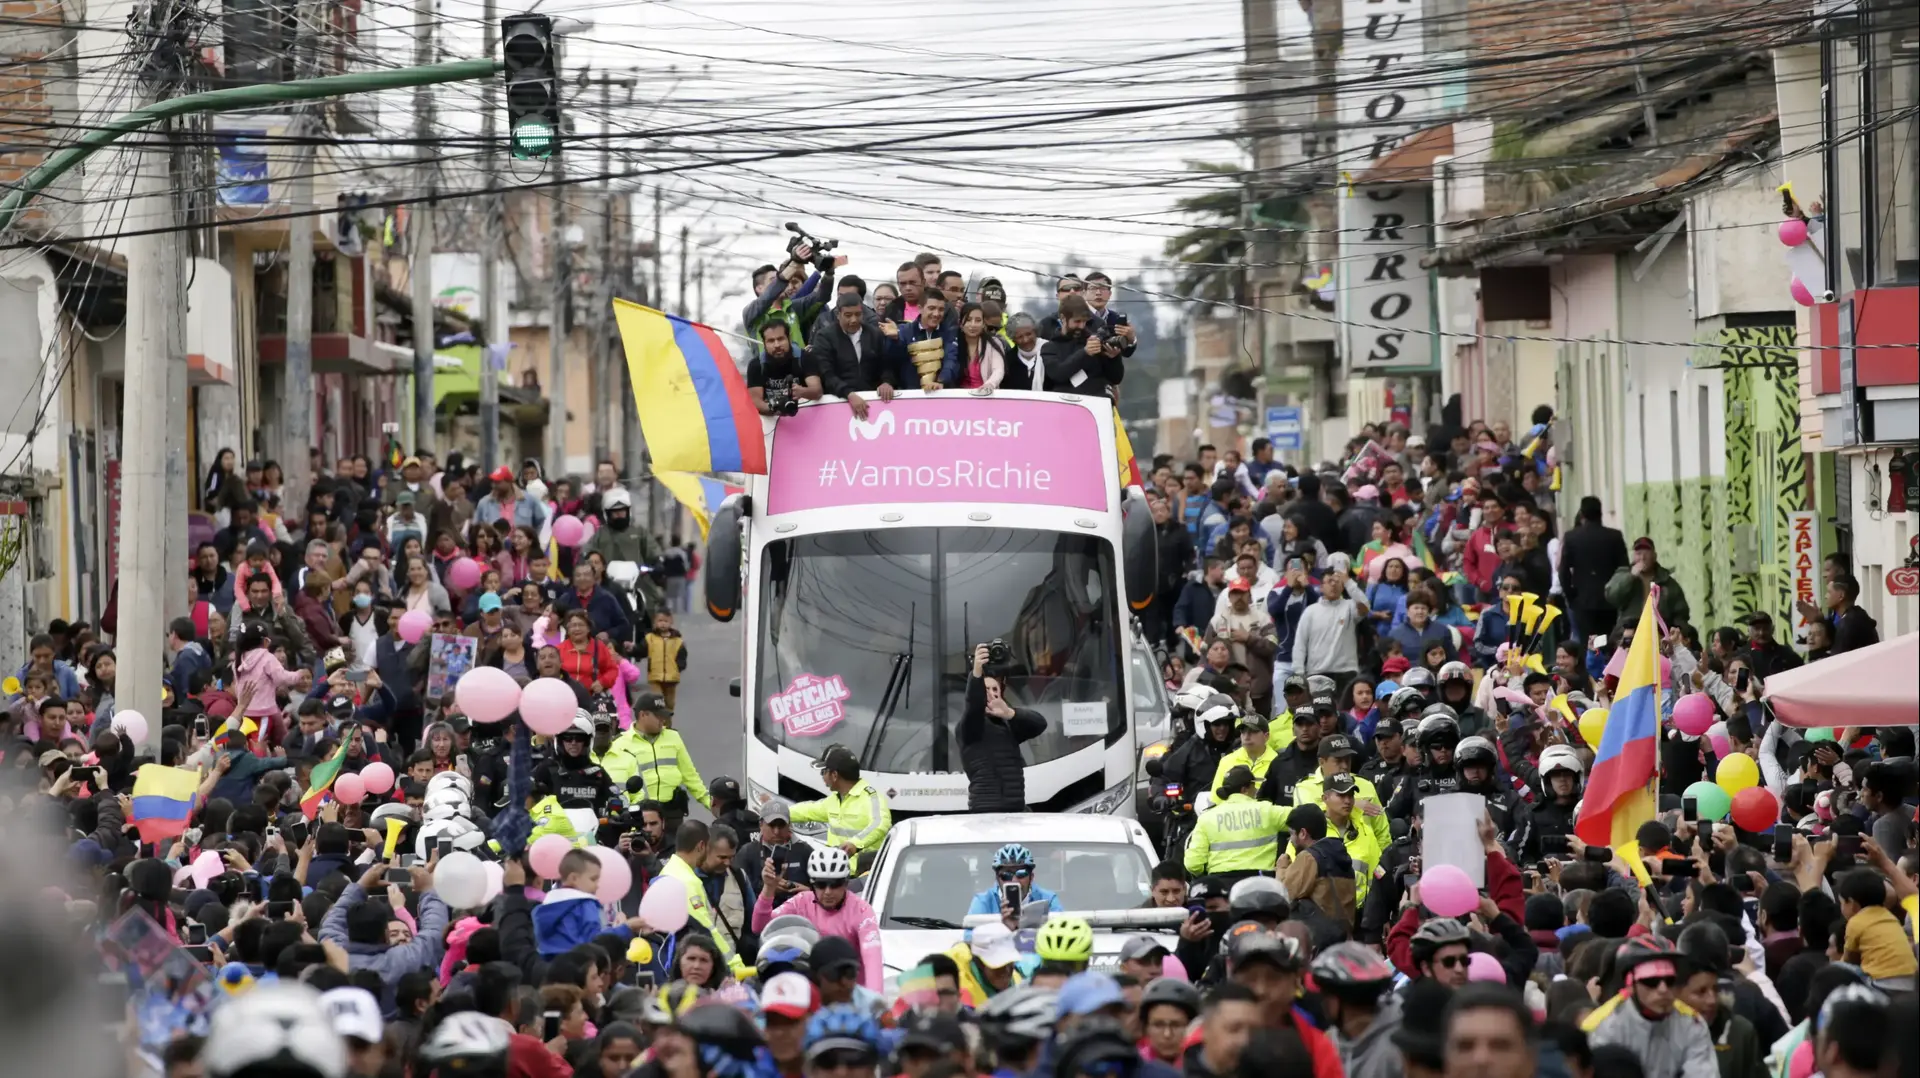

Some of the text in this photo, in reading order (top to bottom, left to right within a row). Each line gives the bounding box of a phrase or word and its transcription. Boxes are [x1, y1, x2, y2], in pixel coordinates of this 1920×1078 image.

[904, 417, 1023, 438] movistar
[818, 459, 1052, 491] #VamosRichie
[1794, 517, 1814, 628] ZAPATER
[770, 678, 847, 721] OFFICIAL
[561, 786, 597, 795] POLICÍA
